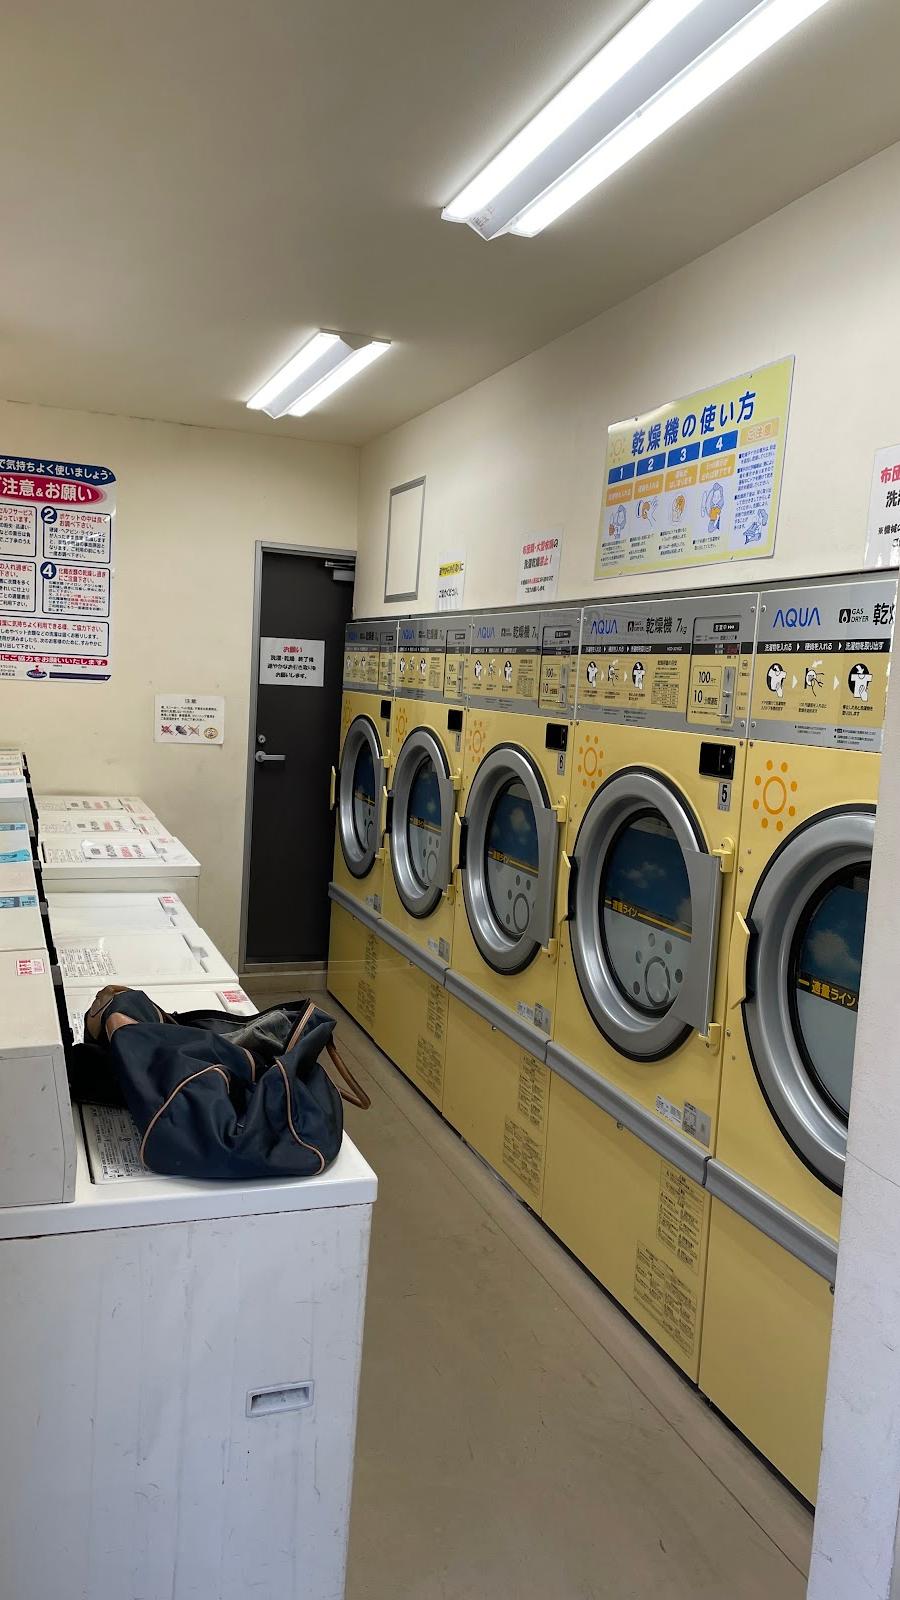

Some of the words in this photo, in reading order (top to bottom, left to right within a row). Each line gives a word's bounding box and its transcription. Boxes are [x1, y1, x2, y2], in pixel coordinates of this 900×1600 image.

[631, 391, 756, 456] 乾燥機の使い方
[715, 437, 724, 451] 4
[680, 448, 687, 461] 3
[647, 458, 654, 471] 2
[620, 467, 625, 477] 1
[0, 477, 92, 501] 注意&お願い
[886, 490, 900, 508] 洗
[44, 507, 55, 522] 2
[879, 524, 900, 535] ※機械
[42, 564, 54, 578] 4
[773, 607, 820, 628] AQUA
[851, 615, 868, 623] DRYER
[591, 619, 618, 635] AQUA
[646, 616, 673, 634] 乾燥機
[477, 626, 496, 639] AQUA
[0, 655, 107, 666] にご協力をお願いいたします。
[721, 784, 728, 803] 5
[812, 979, 856, 1007] 適量ライン
